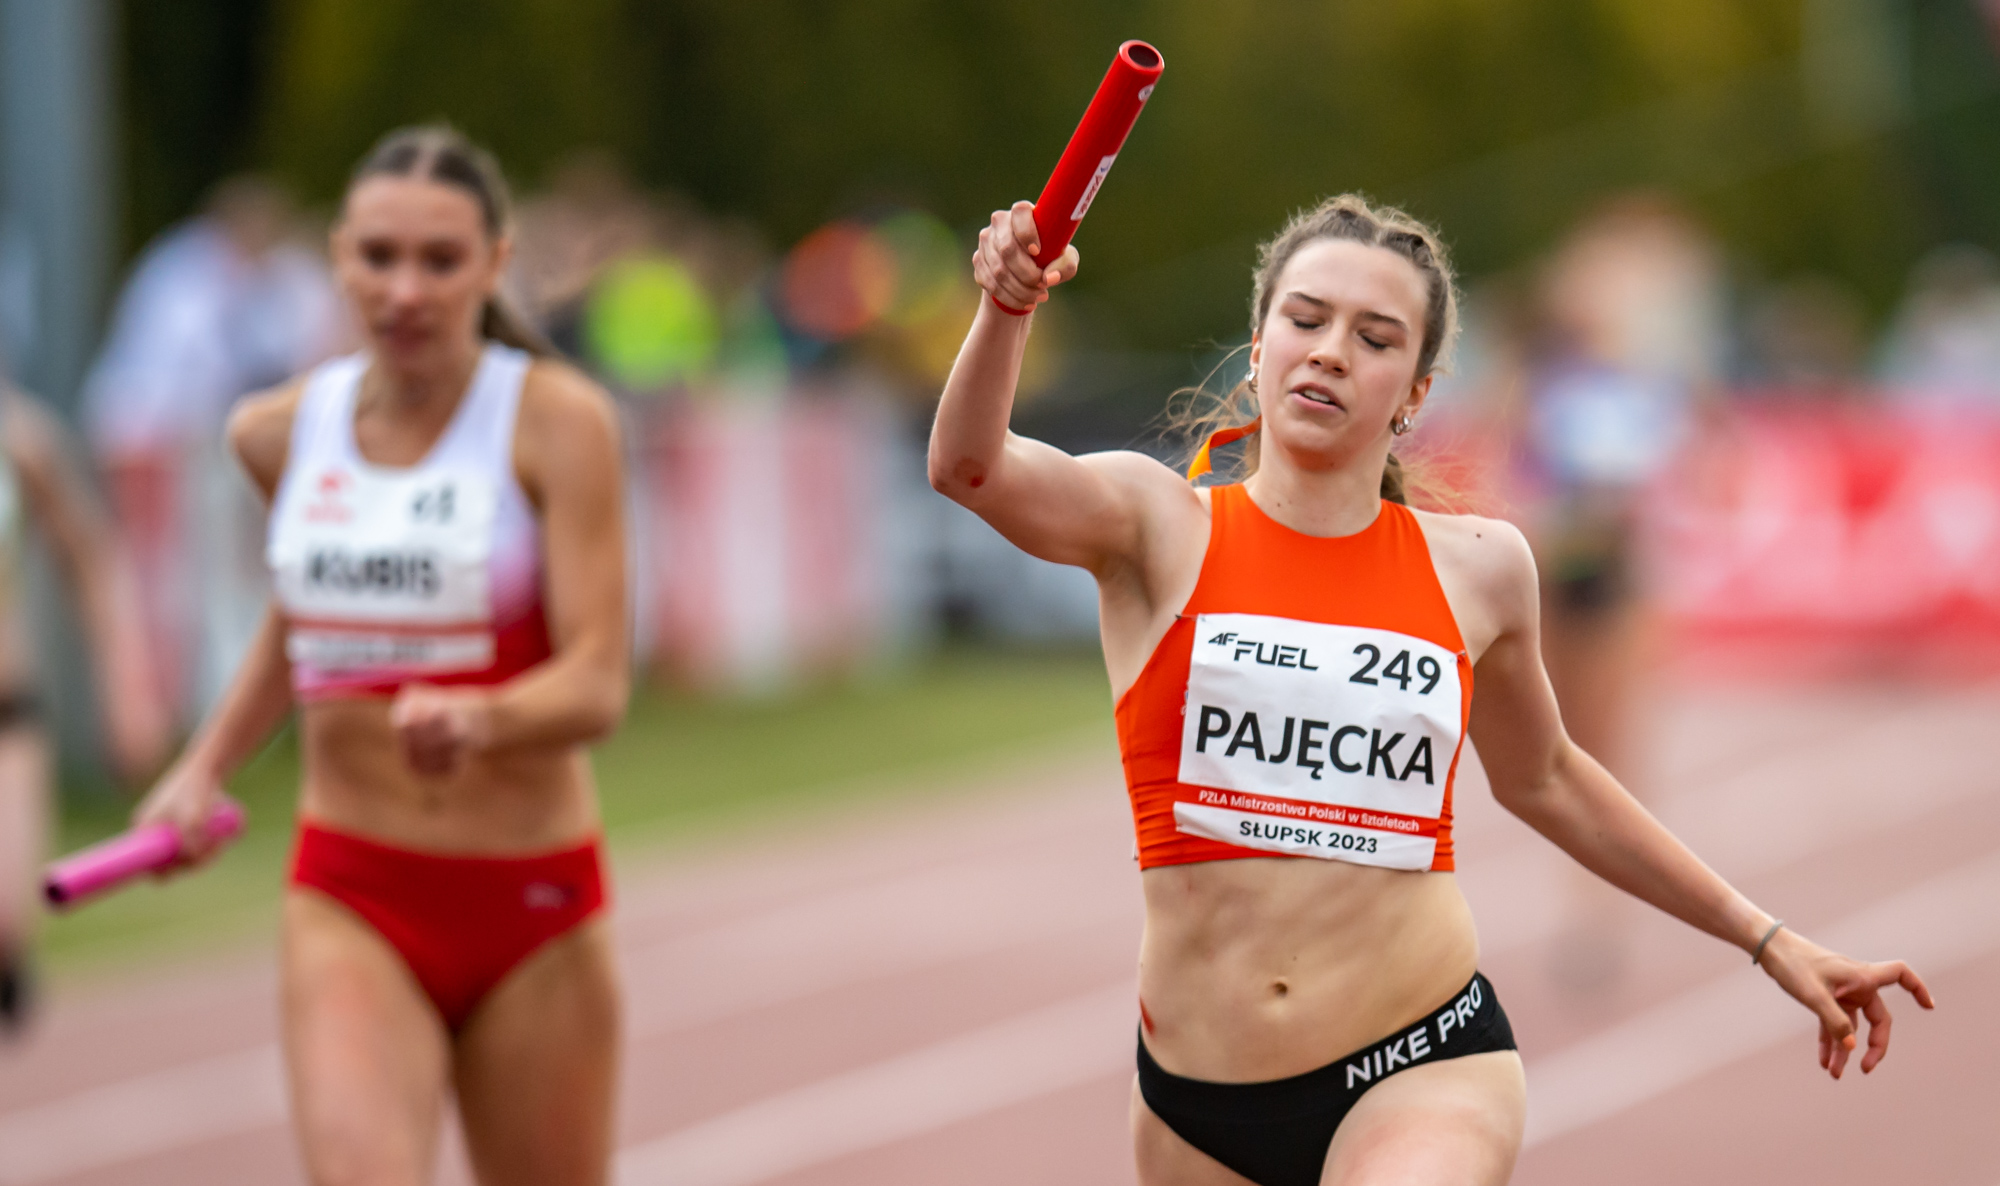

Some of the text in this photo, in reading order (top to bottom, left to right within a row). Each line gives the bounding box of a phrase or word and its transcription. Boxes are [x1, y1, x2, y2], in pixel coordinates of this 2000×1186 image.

[1233, 640, 1319, 671] FUEL
[1349, 643, 1441, 695] 249
[1195, 704, 1434, 785] PAJĘCKA
[1198, 790, 1420, 833] PZLA Mistrzostwa Polski w Sztafetach
[1239, 821, 1378, 853] SŁUPSK 2023
[1346, 979, 1482, 1089] NIKE PRO
